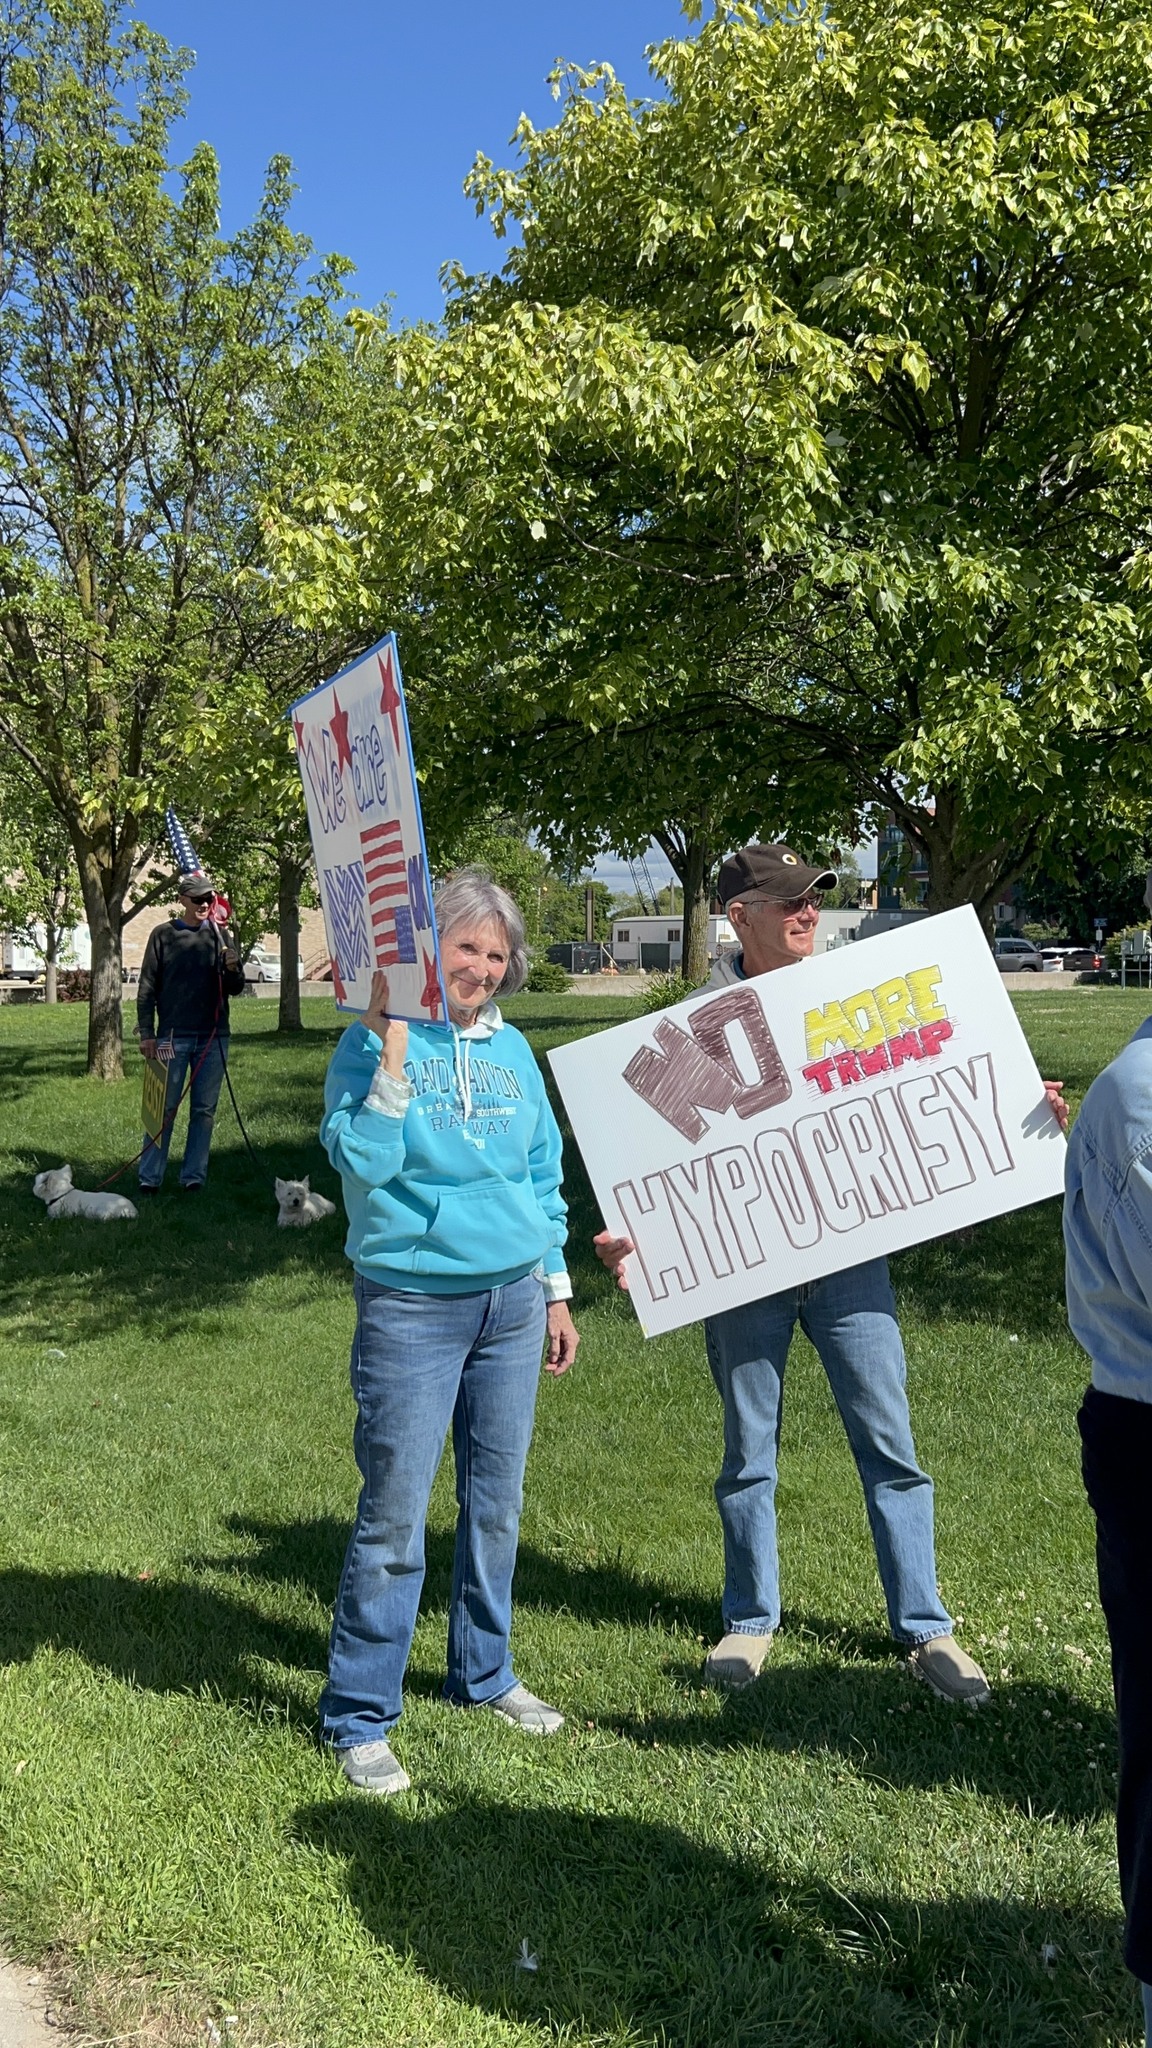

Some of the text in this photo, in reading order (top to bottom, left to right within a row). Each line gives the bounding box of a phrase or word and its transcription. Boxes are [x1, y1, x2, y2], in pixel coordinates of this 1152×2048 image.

[306, 724, 388, 833] We are
[323, 853, 432, 982] NOT OK
[802, 1019, 954, 1095] TRUMP
[804, 964, 949, 1061] MORE
[402, 1058, 450, 1098] RAND
[621, 986, 793, 1145] NO
[431, 1116, 511, 1134] RAWAY
[612, 1053, 1015, 1301] HYPOCRISY
